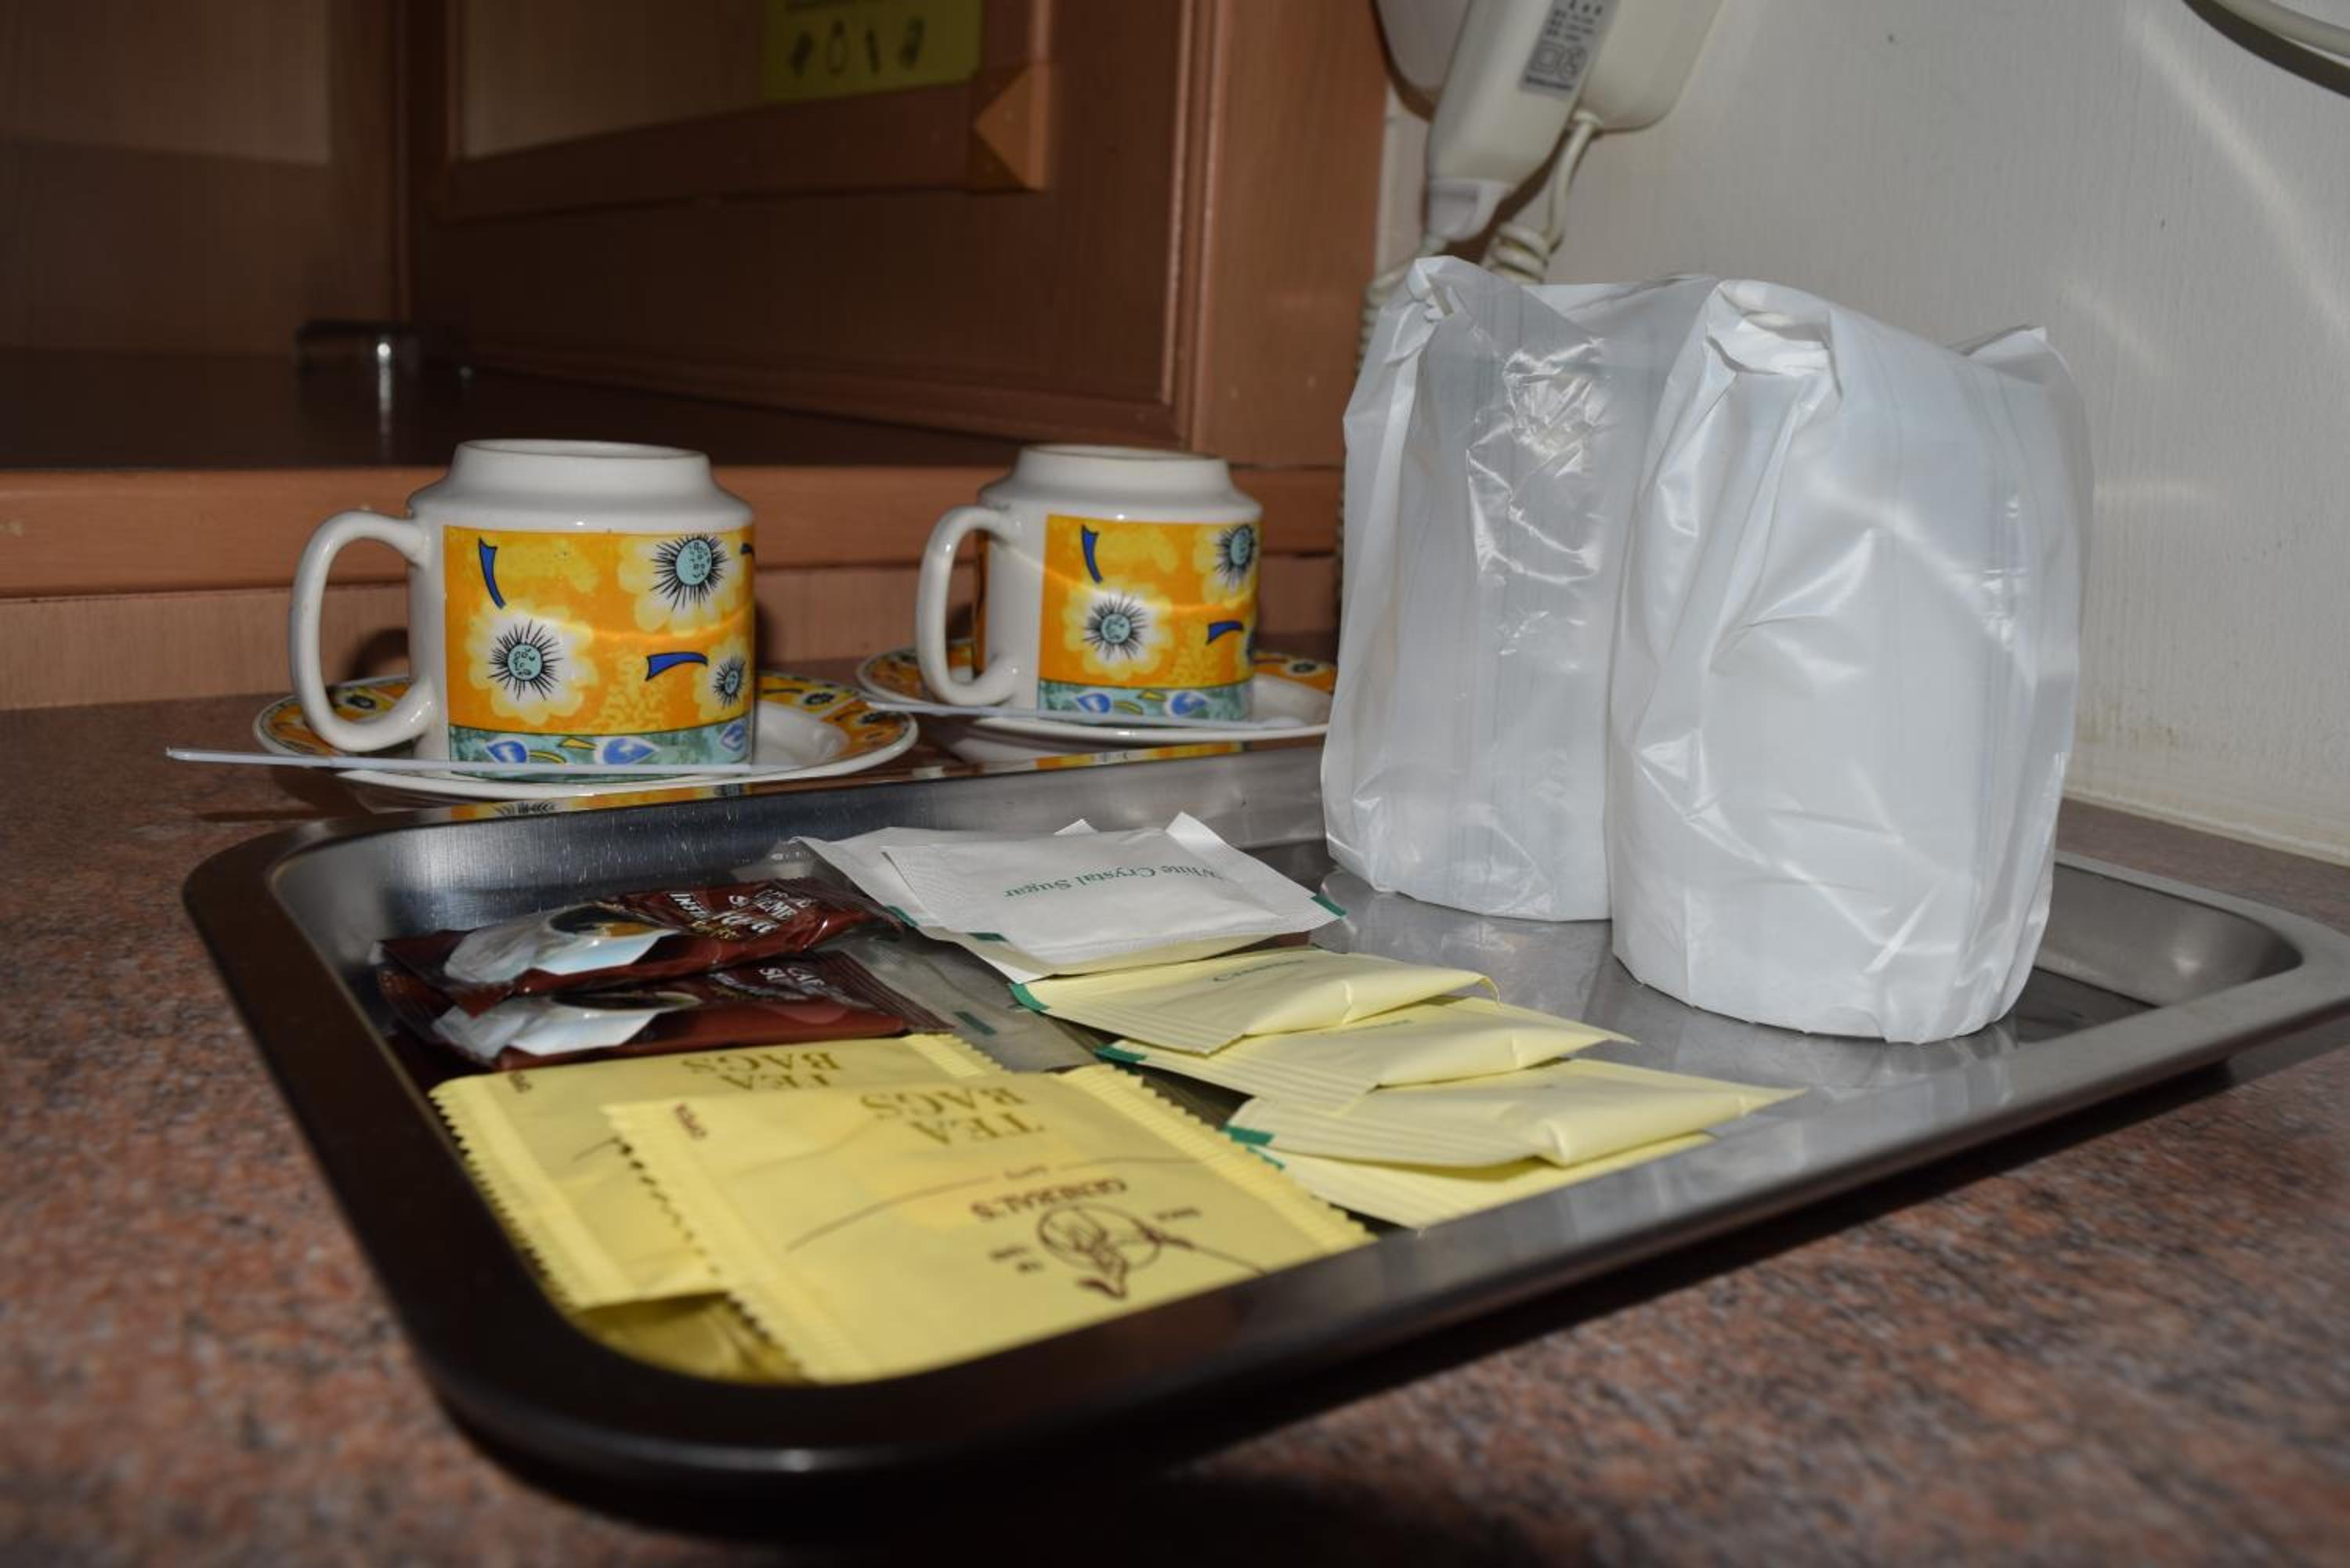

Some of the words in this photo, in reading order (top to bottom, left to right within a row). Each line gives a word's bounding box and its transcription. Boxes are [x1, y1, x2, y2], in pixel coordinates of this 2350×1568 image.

[1075, 867, 1155, 886] Crystal
[1160, 865, 1224, 880] White
[1004, 879, 1072, 898] Sugar
[682, 1052, 841, 1074] BAGS
[860, 1087, 1027, 1120] BAGS
[909, 1112, 1047, 1145] TEA
